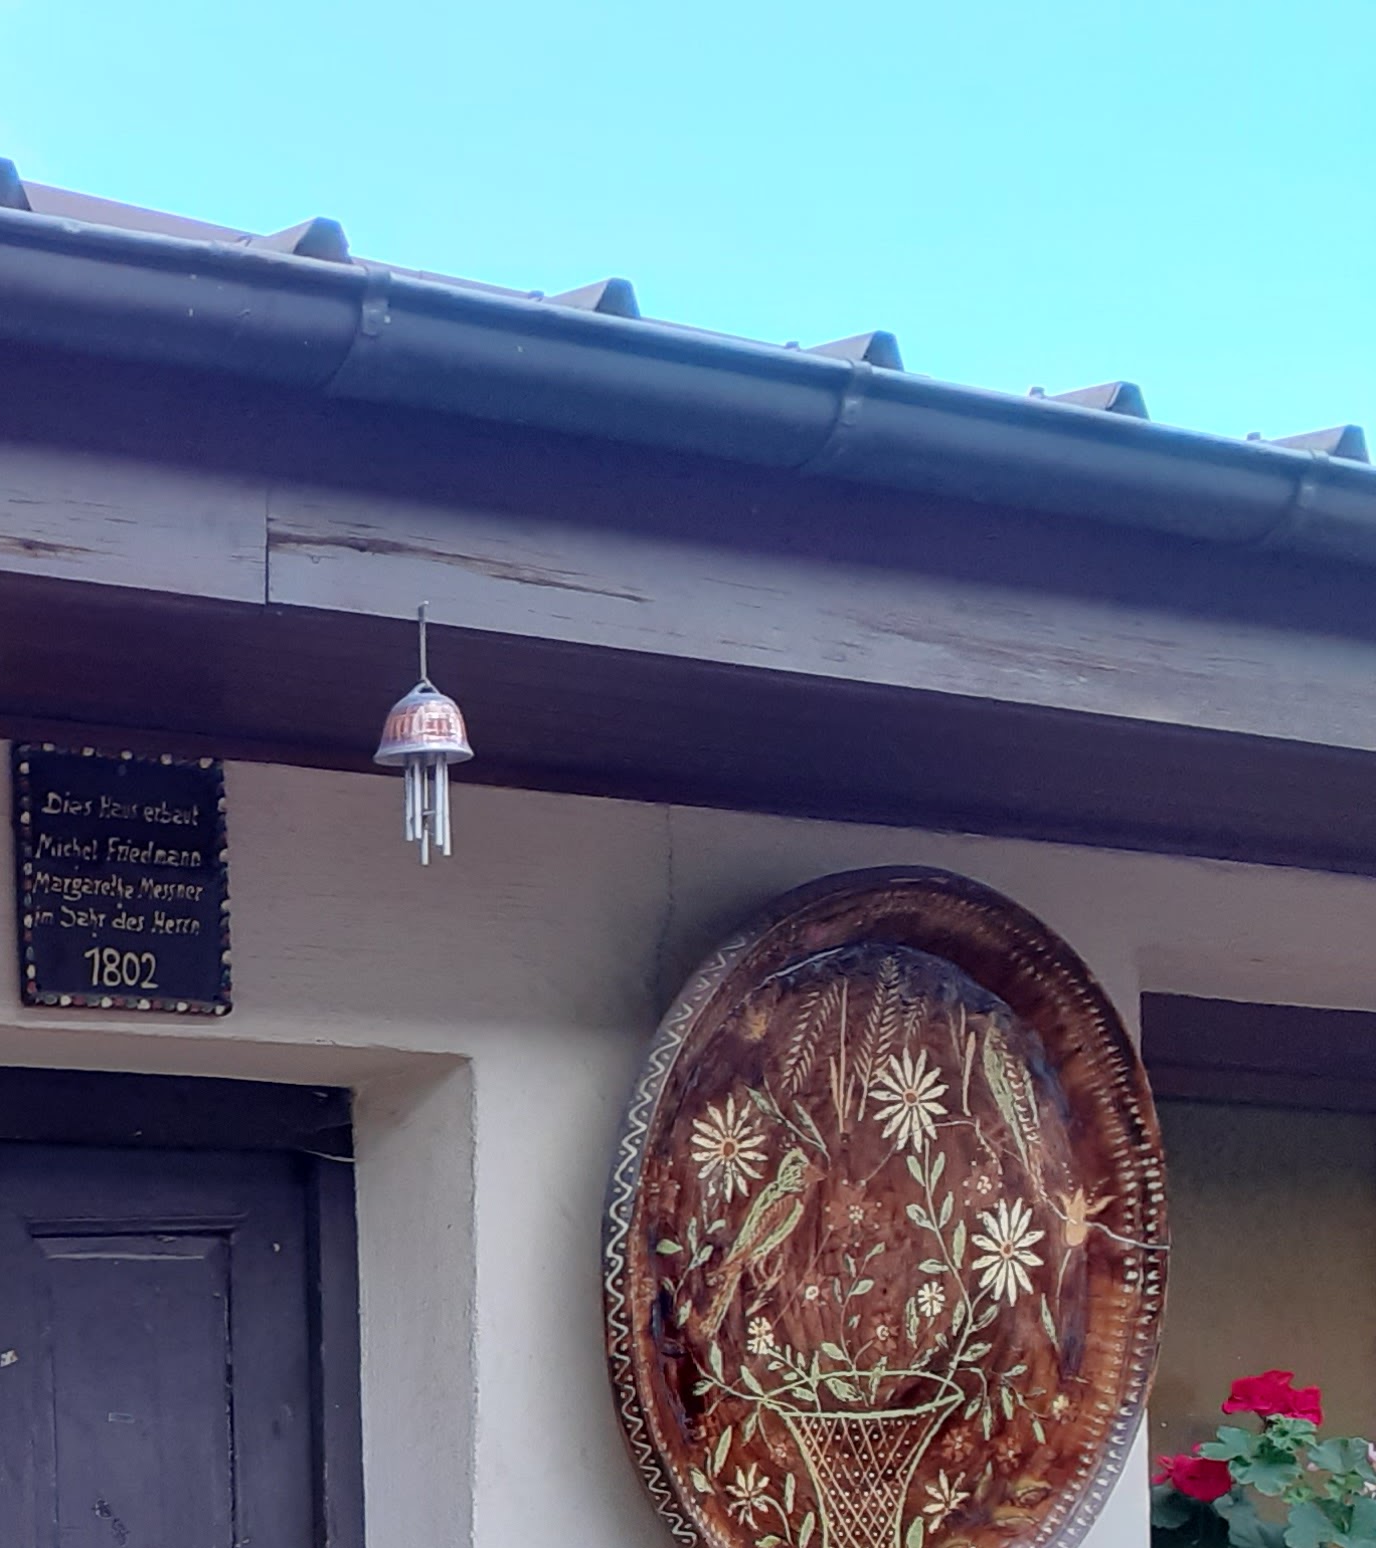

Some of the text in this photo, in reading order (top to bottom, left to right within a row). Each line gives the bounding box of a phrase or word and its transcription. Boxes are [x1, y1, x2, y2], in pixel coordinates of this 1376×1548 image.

[41, 791, 93, 816] Dies
[143, 801, 199, 826] erbaut
[111, 912, 145, 932] des
[84, 947, 159, 989] 1802
